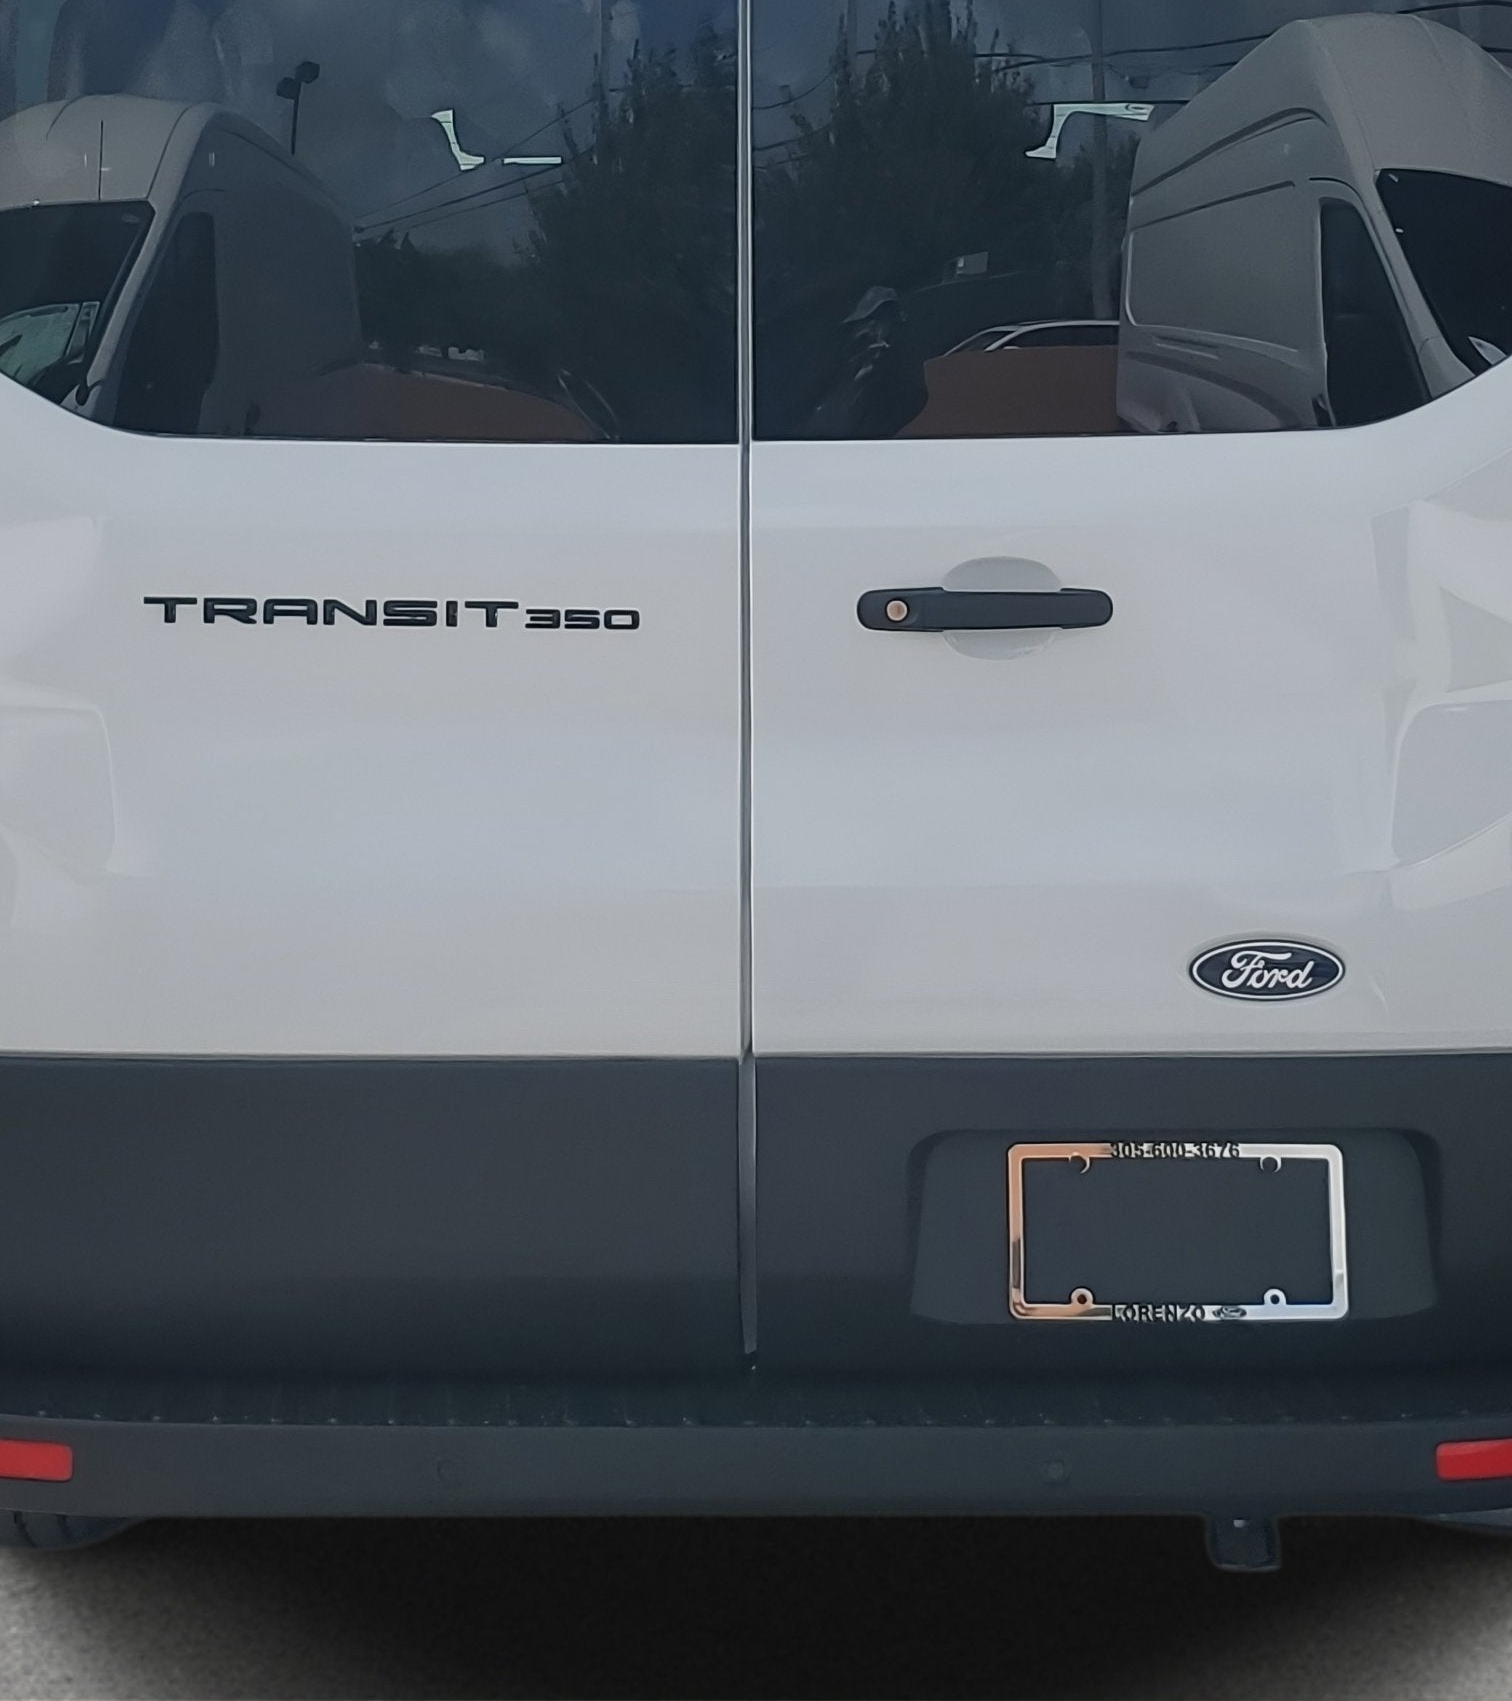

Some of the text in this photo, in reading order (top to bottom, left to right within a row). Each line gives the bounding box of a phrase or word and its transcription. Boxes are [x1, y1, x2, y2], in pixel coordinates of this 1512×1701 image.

[143, 596, 640, 630] TRANSIT 350
[1221, 950, 1314, 989] Ford
[1110, 1140, 1241, 1159] 305-600-3676
[1111, 1302, 1206, 1322] LORENZO
